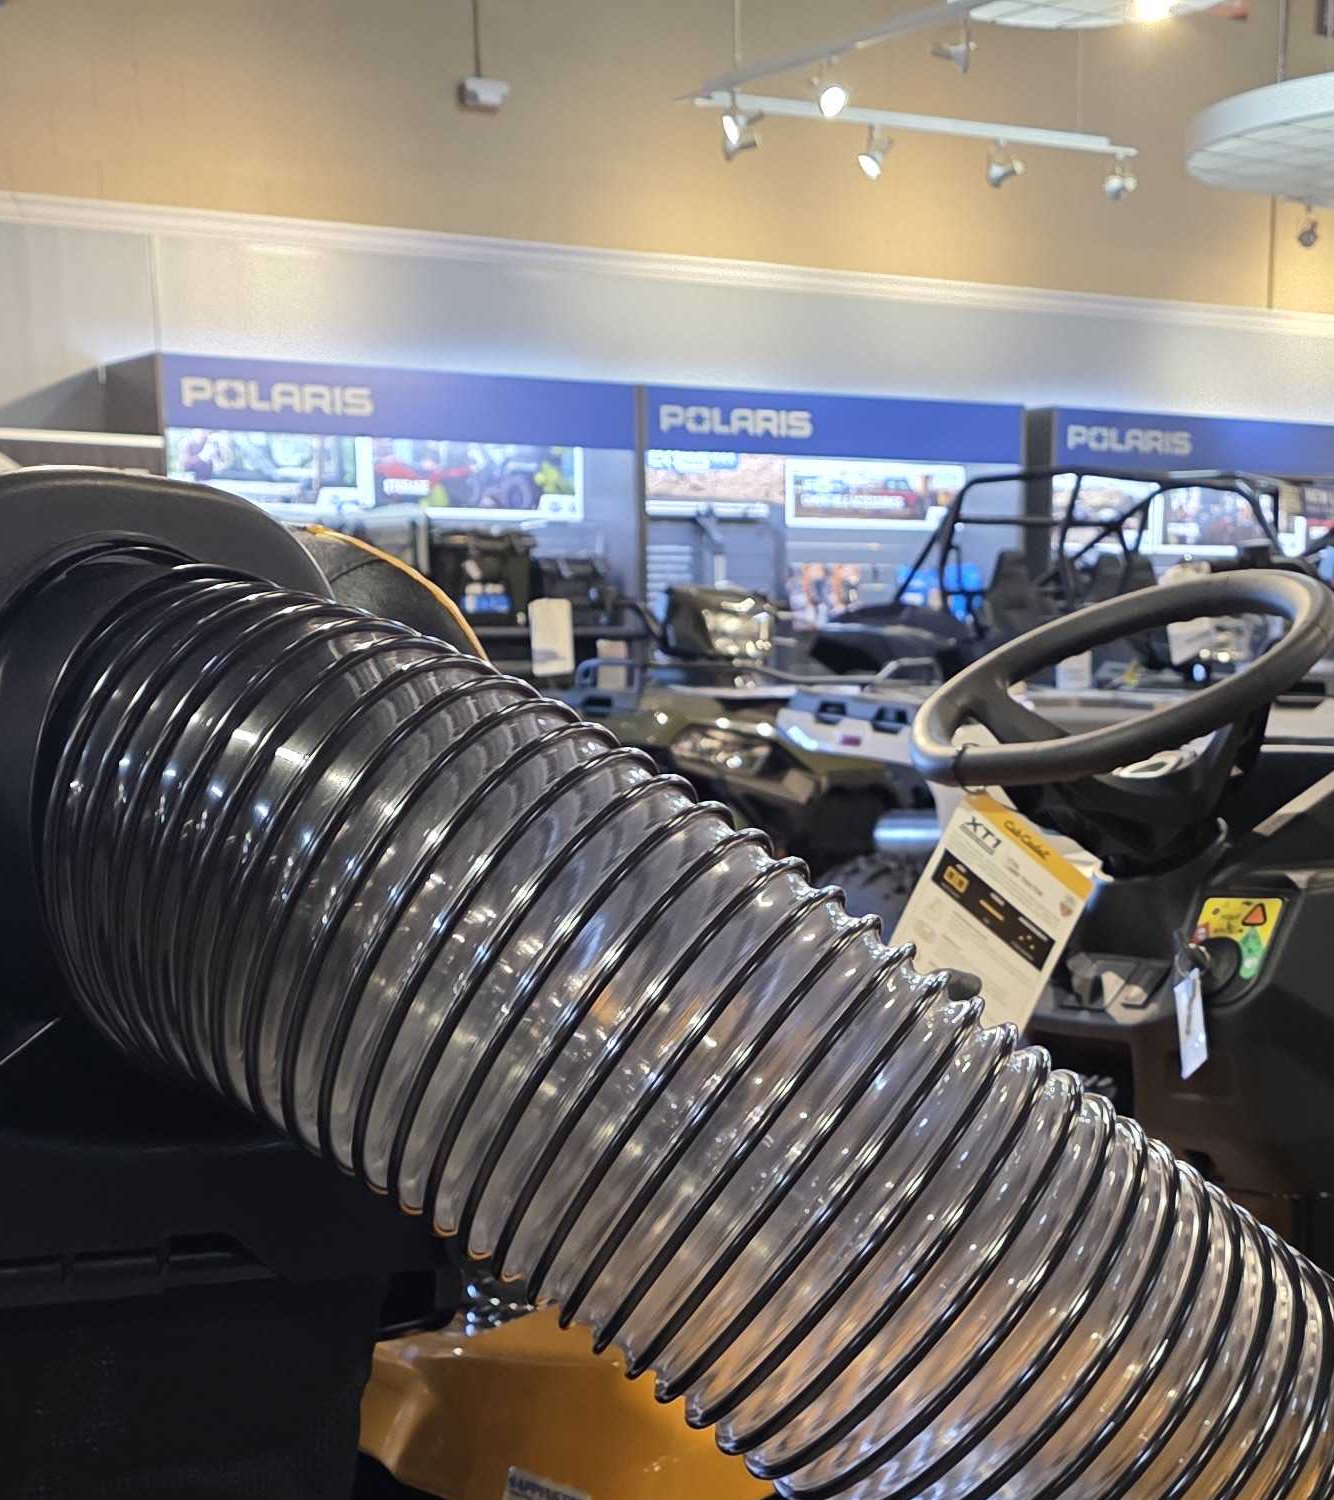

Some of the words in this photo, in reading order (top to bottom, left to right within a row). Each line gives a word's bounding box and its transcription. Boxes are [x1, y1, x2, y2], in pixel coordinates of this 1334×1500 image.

[180, 375, 374, 417] POLARIS
[659, 404, 813, 439] POLARIS
[1067, 424, 1193, 456] POLARIS
[966, 815, 1002, 849] XT1
